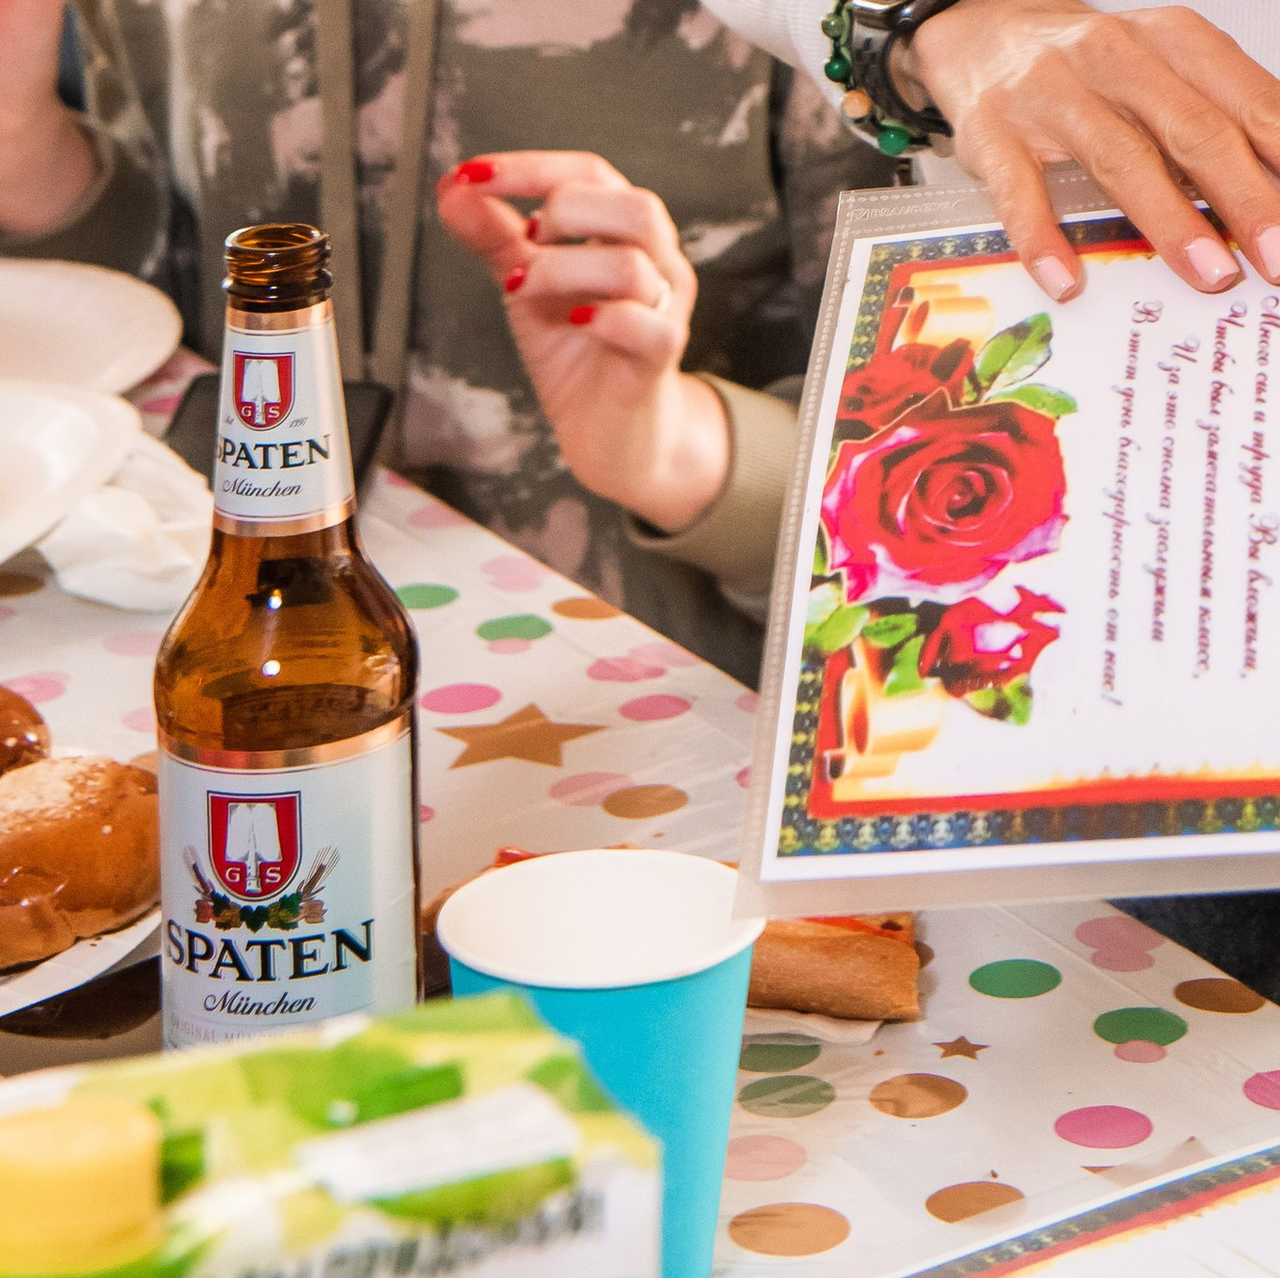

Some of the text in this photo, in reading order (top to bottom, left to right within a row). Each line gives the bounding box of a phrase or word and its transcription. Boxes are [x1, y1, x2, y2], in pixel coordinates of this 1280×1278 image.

[1211, 302, 1247, 374] Чтобы
[1208, 381, 1233, 416] был
[1253, 372, 1267, 403] сил
[241, 406, 280, 419] G S
[1252, 411, 1265, 422] и
[1237, 431, 1270, 504] труда
[223, 478, 302, 497] München
[1100, 301, 1162, 706] В этот день благодарность от нас!
[1141, 336, 1199, 643] И за это сполна заслужили
[1248, 514, 1279, 560] Вы
[225, 867, 281, 884] G S
[167, 918, 375, 983] SPATEN
[203, 989, 317, 1016] München
